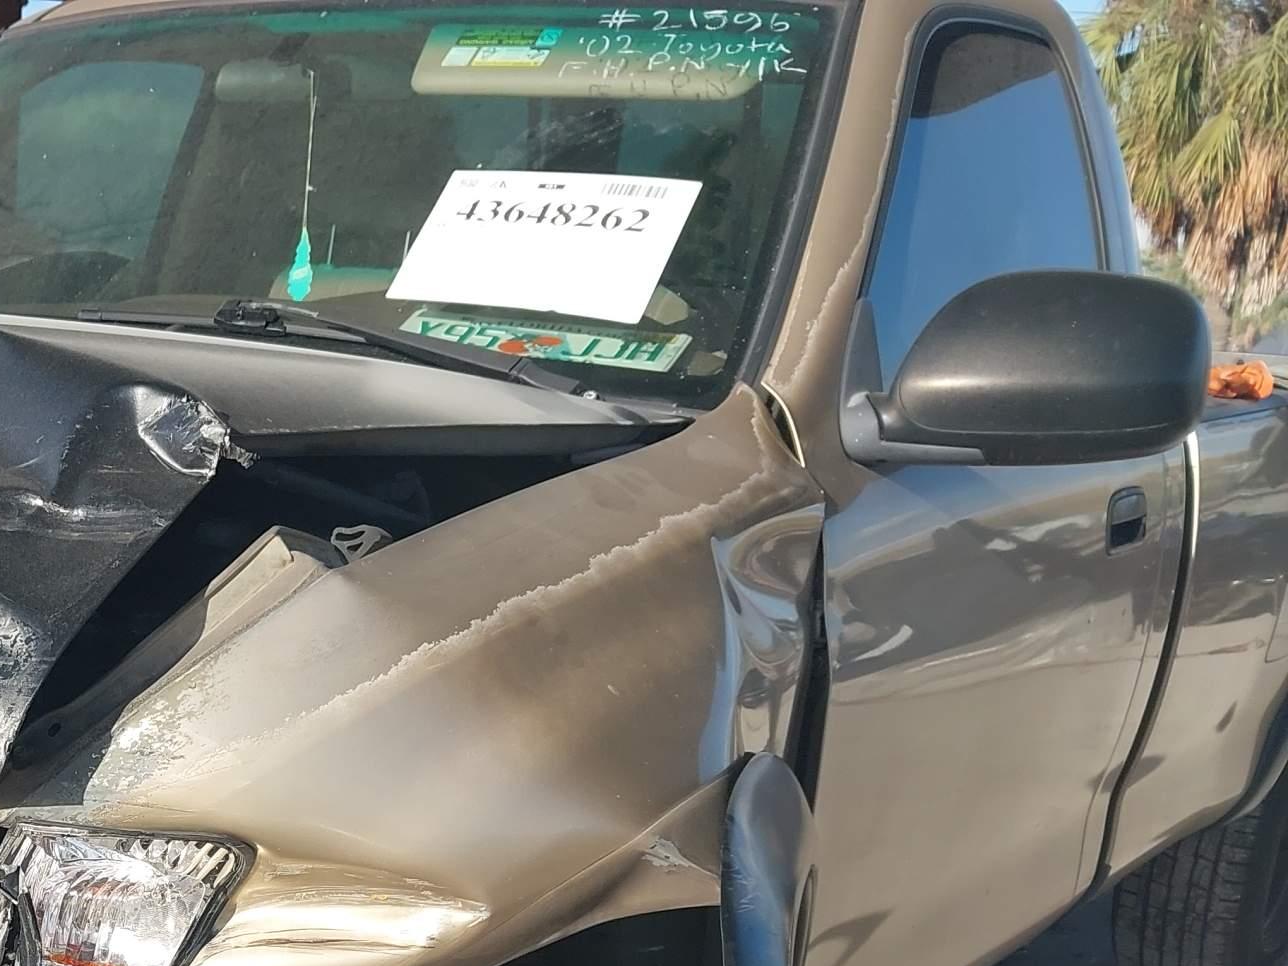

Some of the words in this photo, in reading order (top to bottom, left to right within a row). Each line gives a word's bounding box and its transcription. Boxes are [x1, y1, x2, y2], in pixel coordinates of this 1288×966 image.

[652, 8, 791, 33] 21596
[663, 33, 792, 61] Toyota
[455, 199, 651, 233] 43648262
